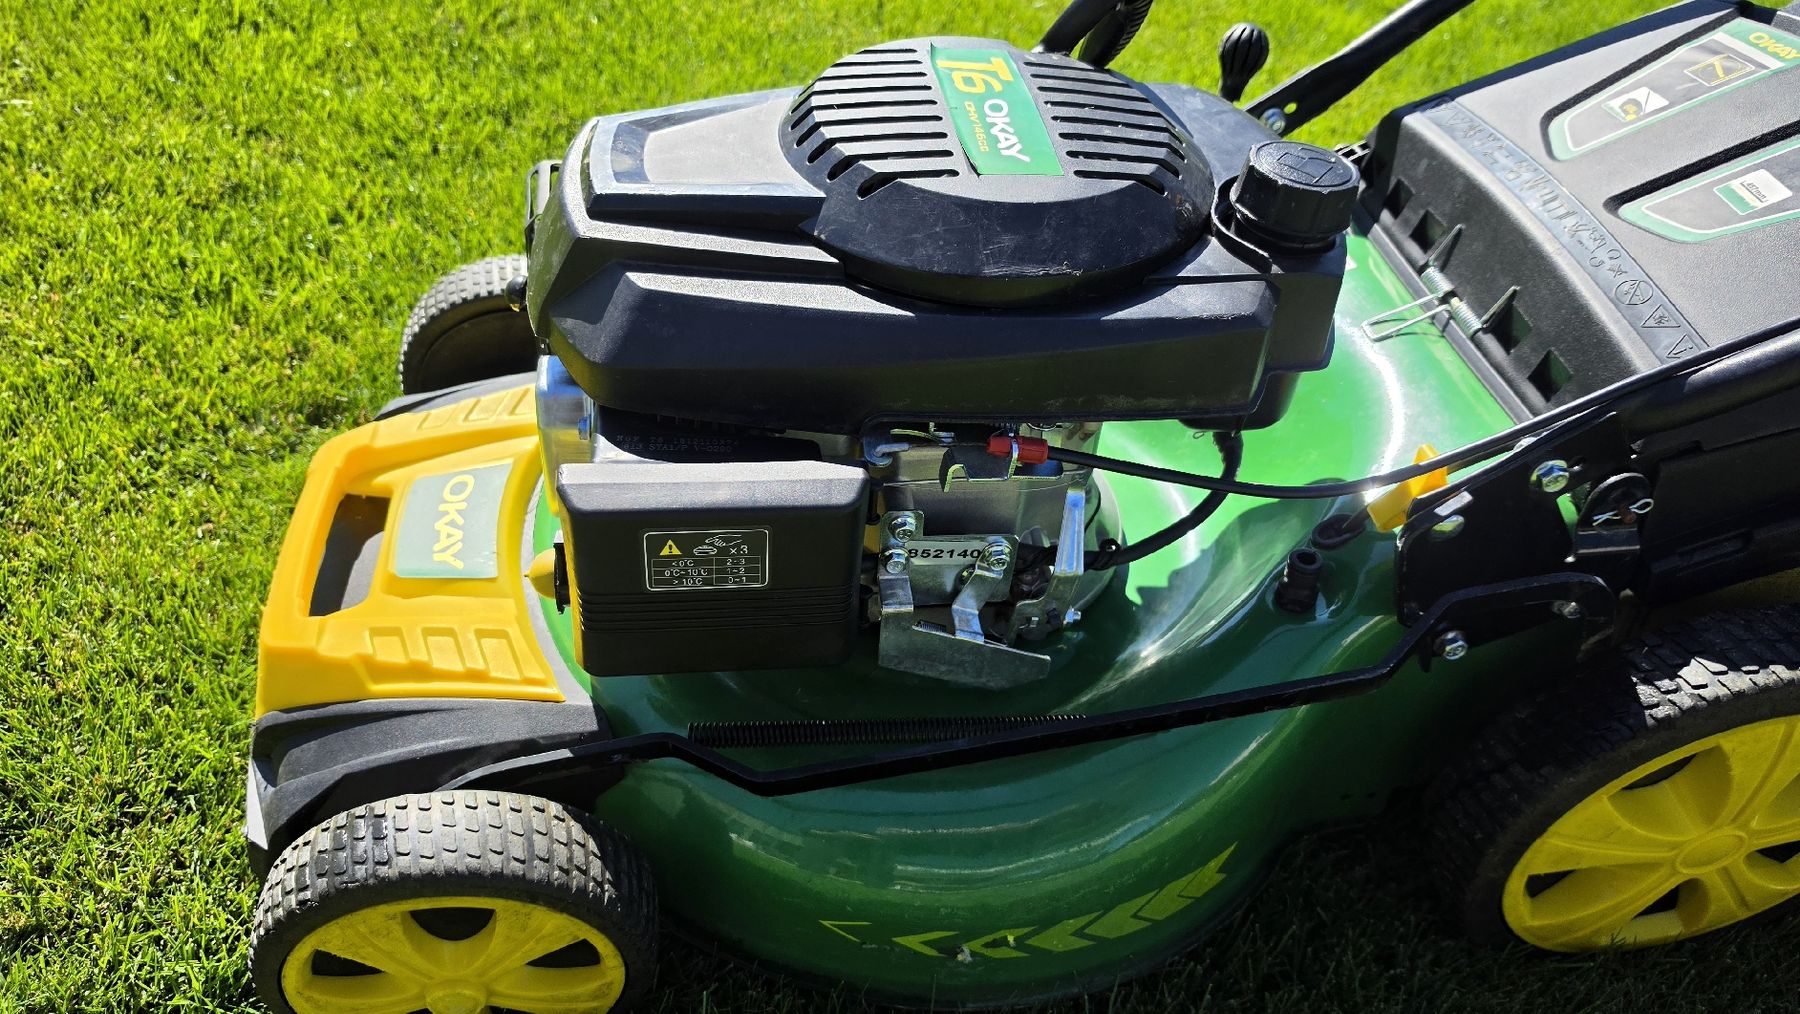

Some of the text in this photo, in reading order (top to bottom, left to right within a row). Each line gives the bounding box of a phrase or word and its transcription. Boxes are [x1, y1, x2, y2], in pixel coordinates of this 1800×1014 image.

[1748, 31, 1800, 60] OKAY
[936, 57, 1014, 94] T6
[983, 99, 1031, 163] OKAY
[432, 474, 475, 570] OKAY
